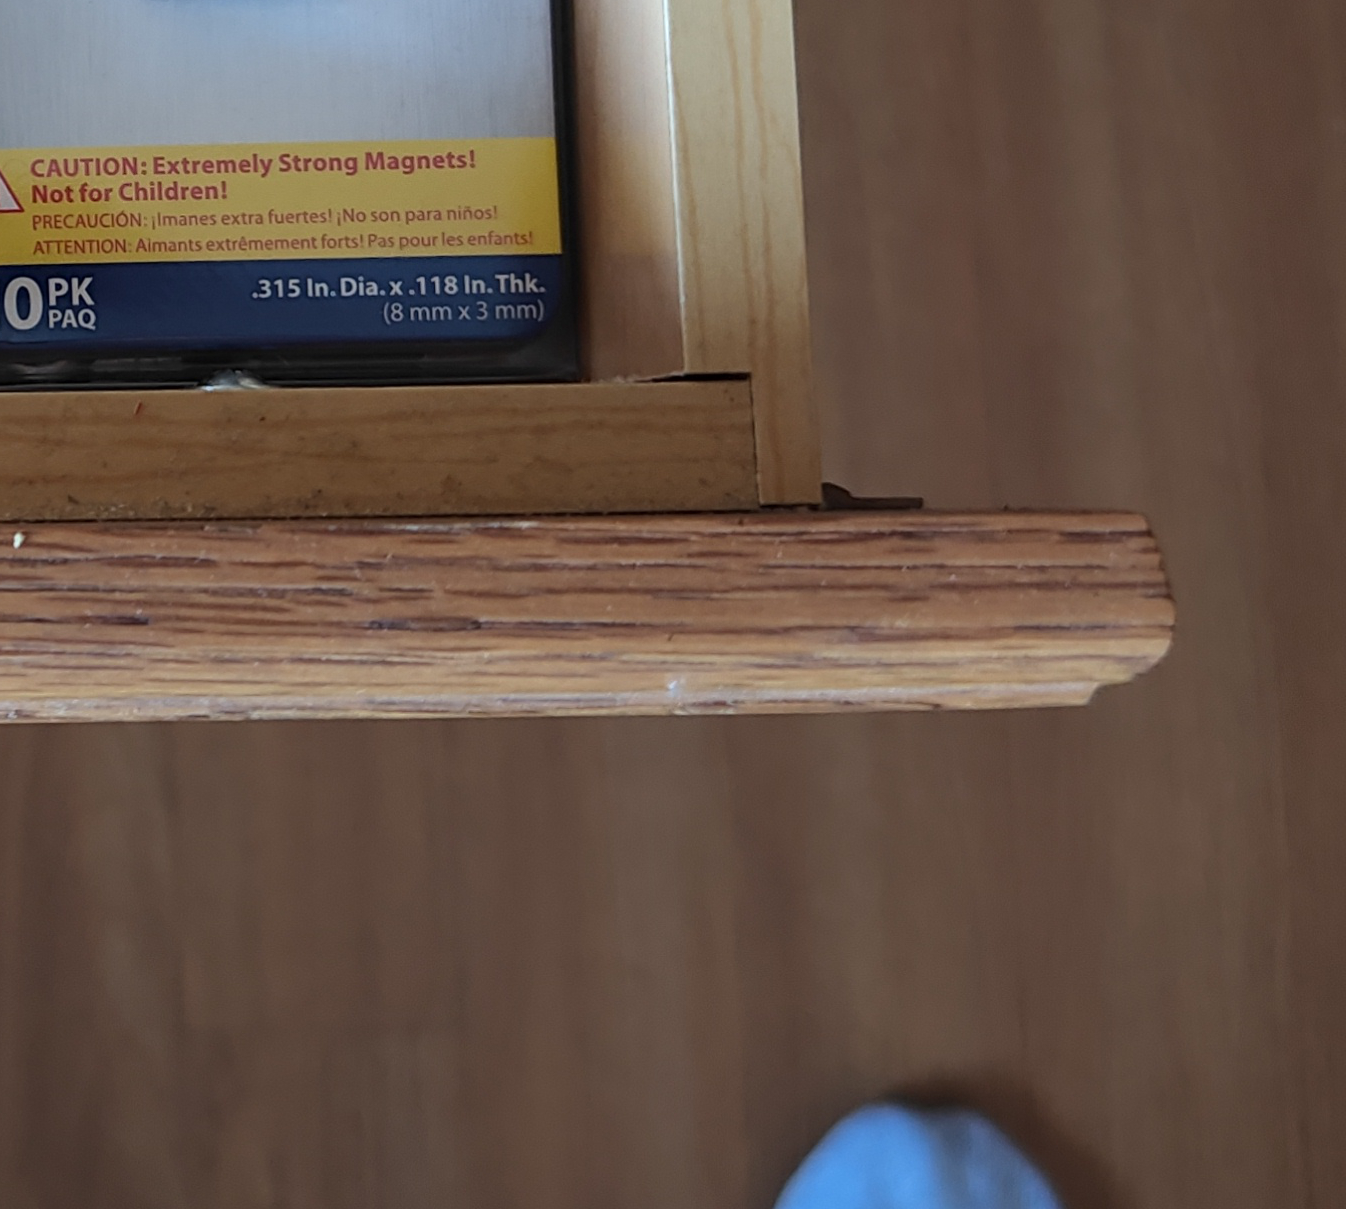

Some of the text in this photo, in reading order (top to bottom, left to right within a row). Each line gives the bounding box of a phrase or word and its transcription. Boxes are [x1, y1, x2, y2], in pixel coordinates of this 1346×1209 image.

[30, 150, 476, 178] CAUTION: Extremely Strong Magnets!
[32, 181, 227, 204] Not for Children!
[32, 206, 497, 230] PRECAUCIÓN: ¡Imanes extra fuertes! ¡No son para niños!
[33, 231, 534, 256] ATTENTION: Aimants extrêmement forts! Pas pour les enfants!
[48, 277, 95, 306] PK
[252, 273, 545, 299] .315 In. Dia. x .118 In. Thk.
[48, 308, 96, 331] PAQ
[383, 300, 545, 325] (8 mm x 3 mm)
